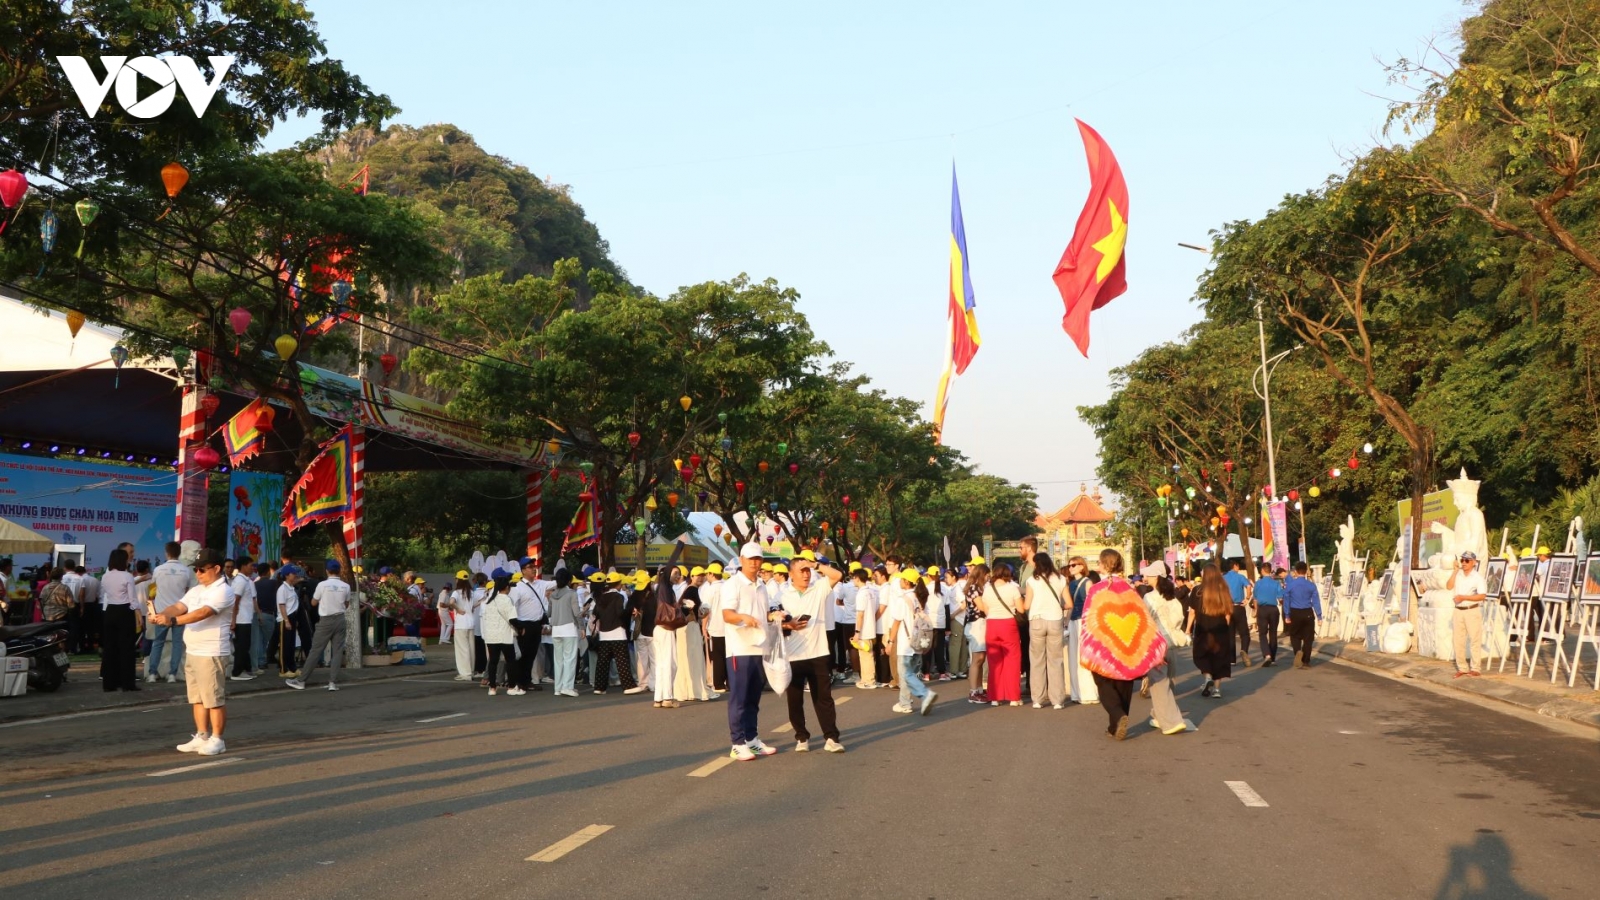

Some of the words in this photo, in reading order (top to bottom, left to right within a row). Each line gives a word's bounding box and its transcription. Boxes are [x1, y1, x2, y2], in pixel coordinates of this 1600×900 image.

[33, 522, 70, 531] WALKING
[73, 524, 87, 532] FOR
[90, 525, 113, 533] PEACE
